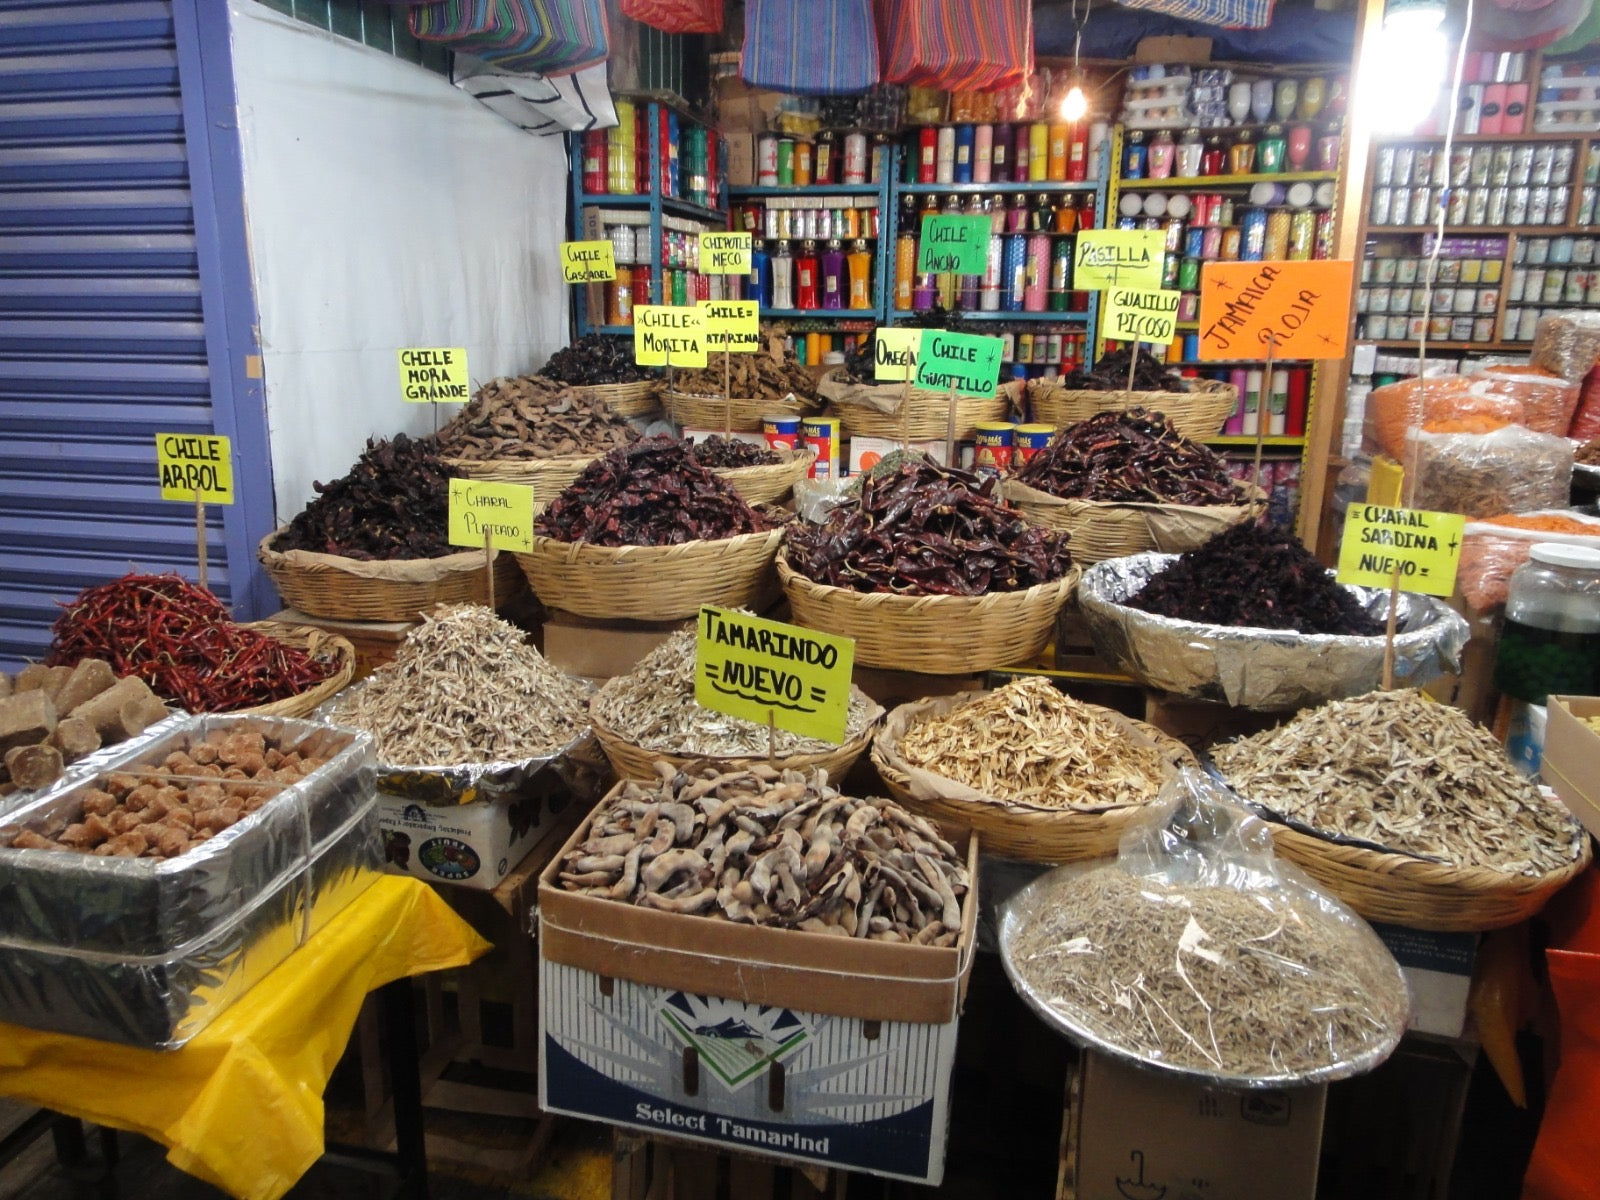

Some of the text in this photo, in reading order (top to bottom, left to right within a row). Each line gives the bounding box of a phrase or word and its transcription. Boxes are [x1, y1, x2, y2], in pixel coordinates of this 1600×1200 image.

[930, 218, 968, 243] CHILE
[567, 245, 600, 262] CHILE
[703, 236, 752, 250] CHIPOTLE
[1078, 241, 1150, 267] PASILLA
[712, 252, 741, 267] MECO
[643, 310, 691, 328] CHILE
[1203, 265, 1281, 349] JAMAICA
[1257, 289, 1321, 347] ROJA
[1117, 312, 1171, 338] PICOSO
[643, 332, 699, 353] MORITA
[706, 333, 760, 344] ATARINA
[932, 337, 977, 363] CHILE
[401, 350, 453, 366] CHILE
[408, 368, 451, 383] MORA
[406, 384, 468, 400] GRANDE
[164, 437, 220, 461] CHILE
[163, 464, 227, 492] ARBOL
[466, 487, 512, 508] CHARAL
[464, 511, 519, 537] PLATEADO
[1364, 506, 1429, 528] CHARAL
[1361, 527, 1438, 551] SARDINA
[1358, 554, 1417, 576] NUEVO
[702, 608, 838, 670] TAMARINDO
[723, 659, 802, 701] NUEVO
[636, 1103, 829, 1154] Select Tamarind
